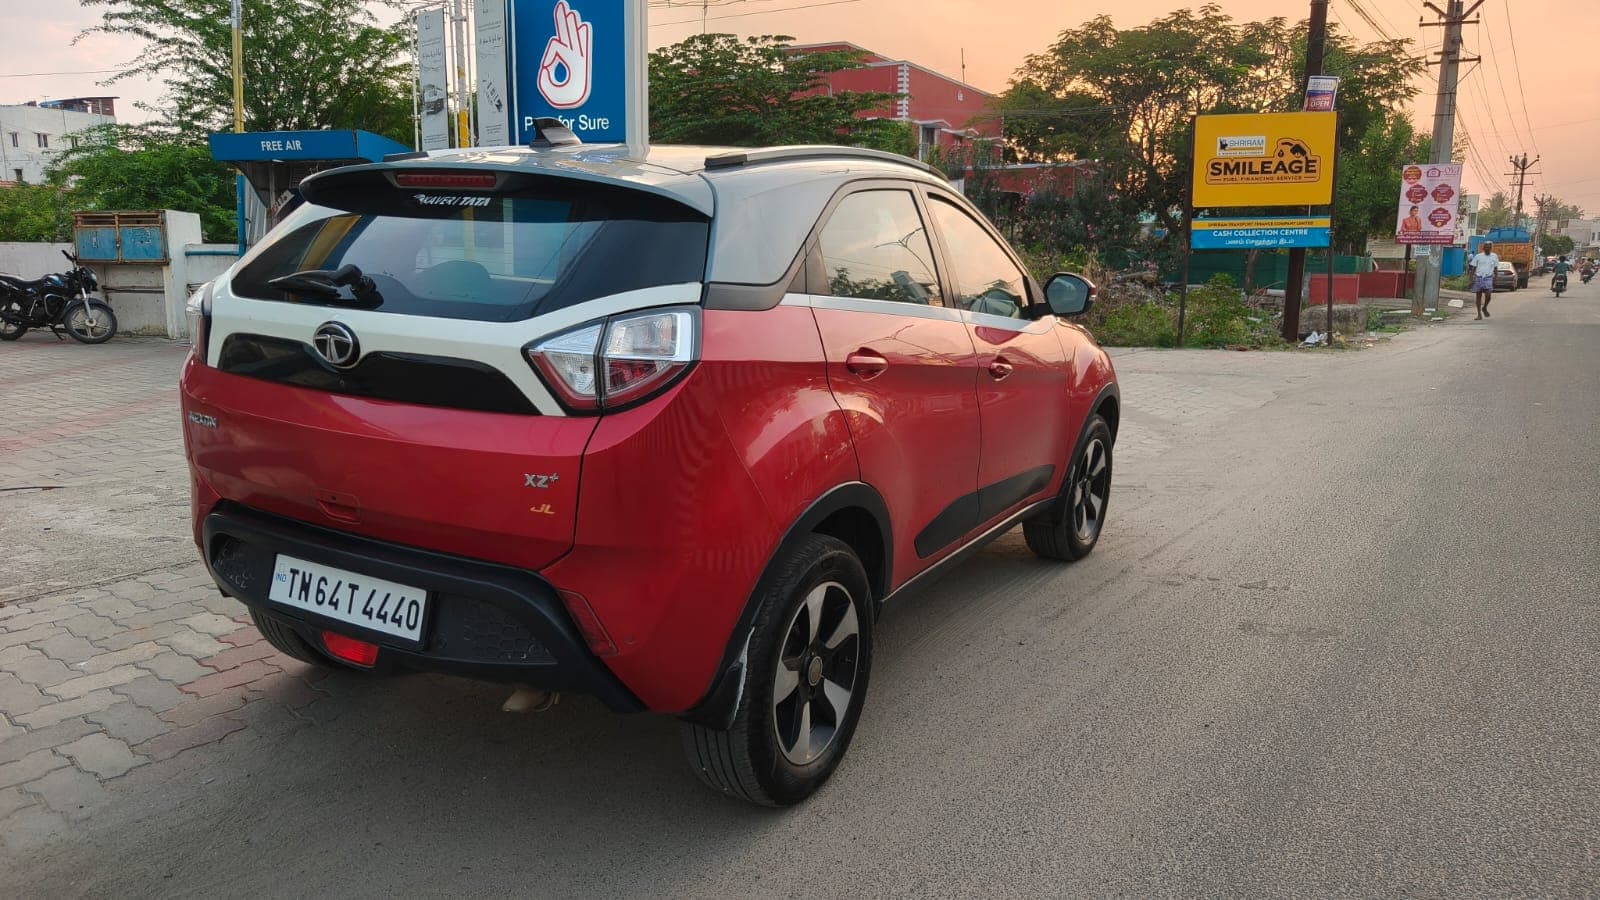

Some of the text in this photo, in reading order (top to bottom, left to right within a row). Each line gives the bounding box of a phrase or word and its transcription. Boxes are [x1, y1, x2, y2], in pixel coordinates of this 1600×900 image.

[578, 114, 610, 131] Sure
[260, 139, 303, 152] FREE AIR
[1229, 139, 1264, 147] SHRIRAM
[1210, 159, 1317, 176] SMILEAGE
[459, 196, 492, 207] TATA
[1233, 229, 1279, 237] COLLECTION
[1279, 228, 1308, 236] CENTRE
